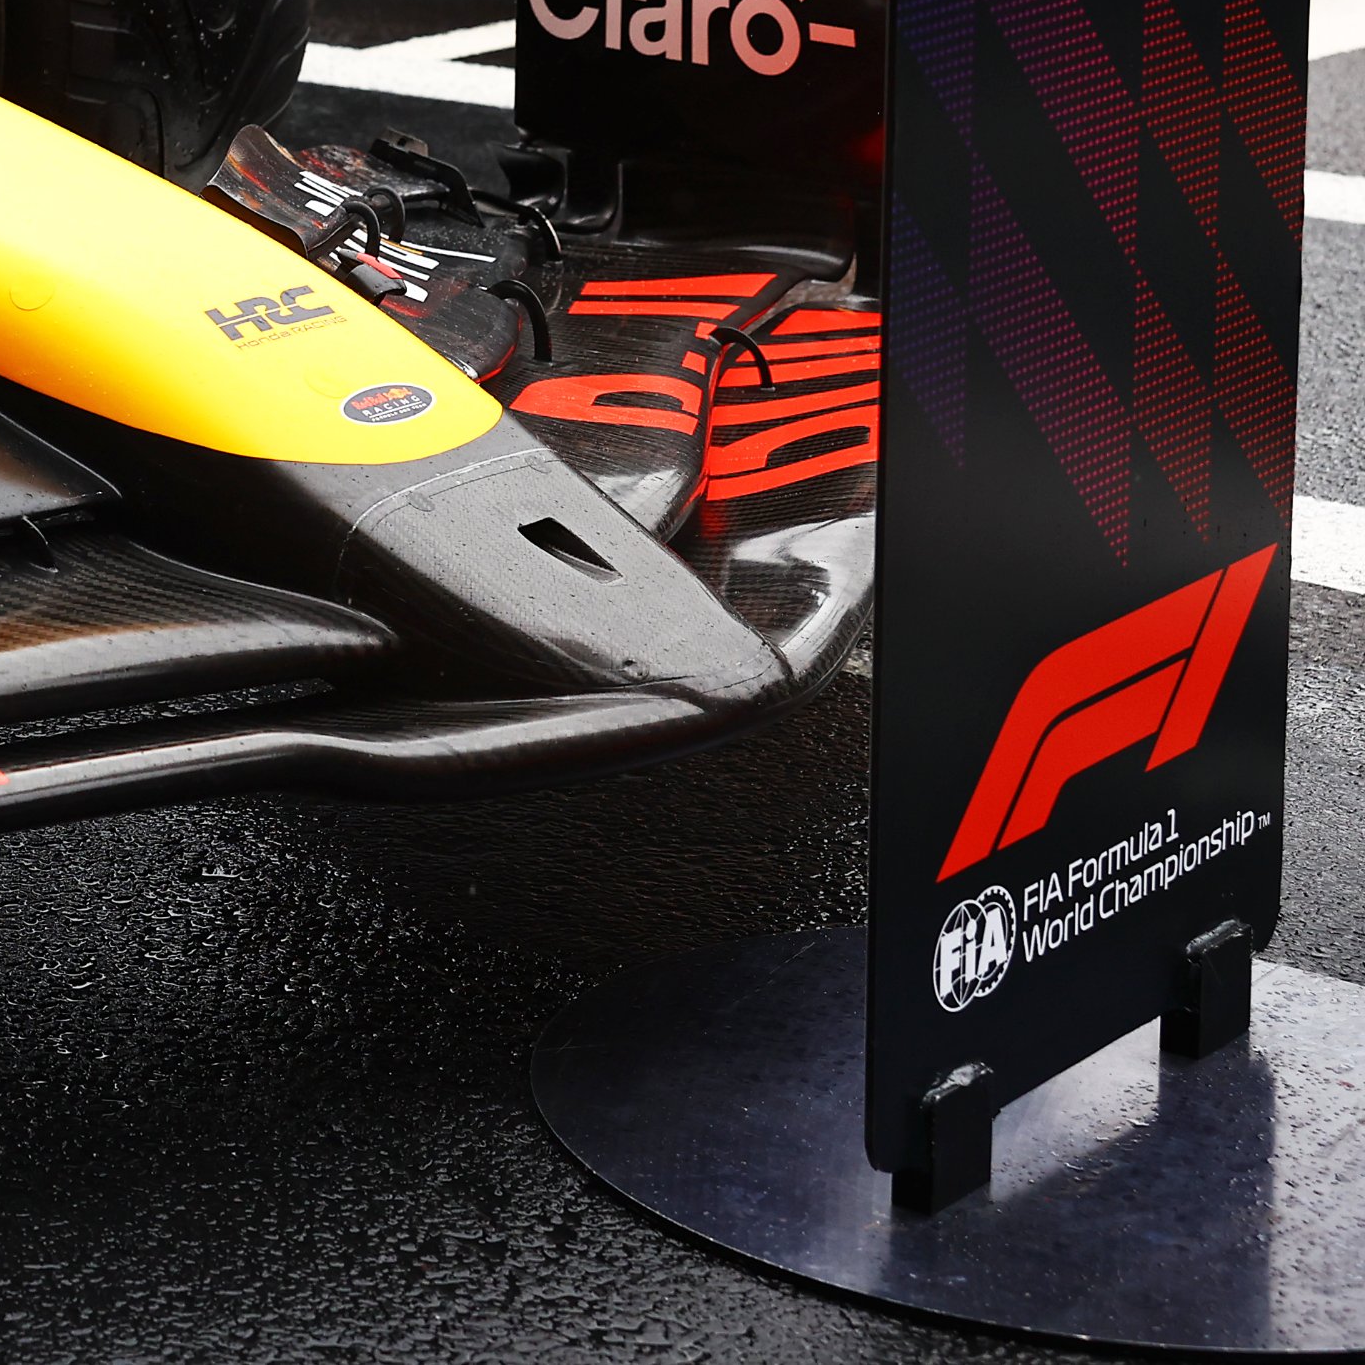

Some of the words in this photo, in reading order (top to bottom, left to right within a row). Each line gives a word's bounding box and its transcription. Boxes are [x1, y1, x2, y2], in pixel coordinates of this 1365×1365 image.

[235, 329, 291, 350] Honda
[292, 315, 347, 335] RACING
[362, 394, 421, 416] RACING
[1022, 895, 1095, 963] World
[1099, 810, 1255, 919] Championship
[1023, 872, 1063, 921] FIA
[1068, 821, 1163, 897] Formula
[1165, 808, 1179, 842] 1
